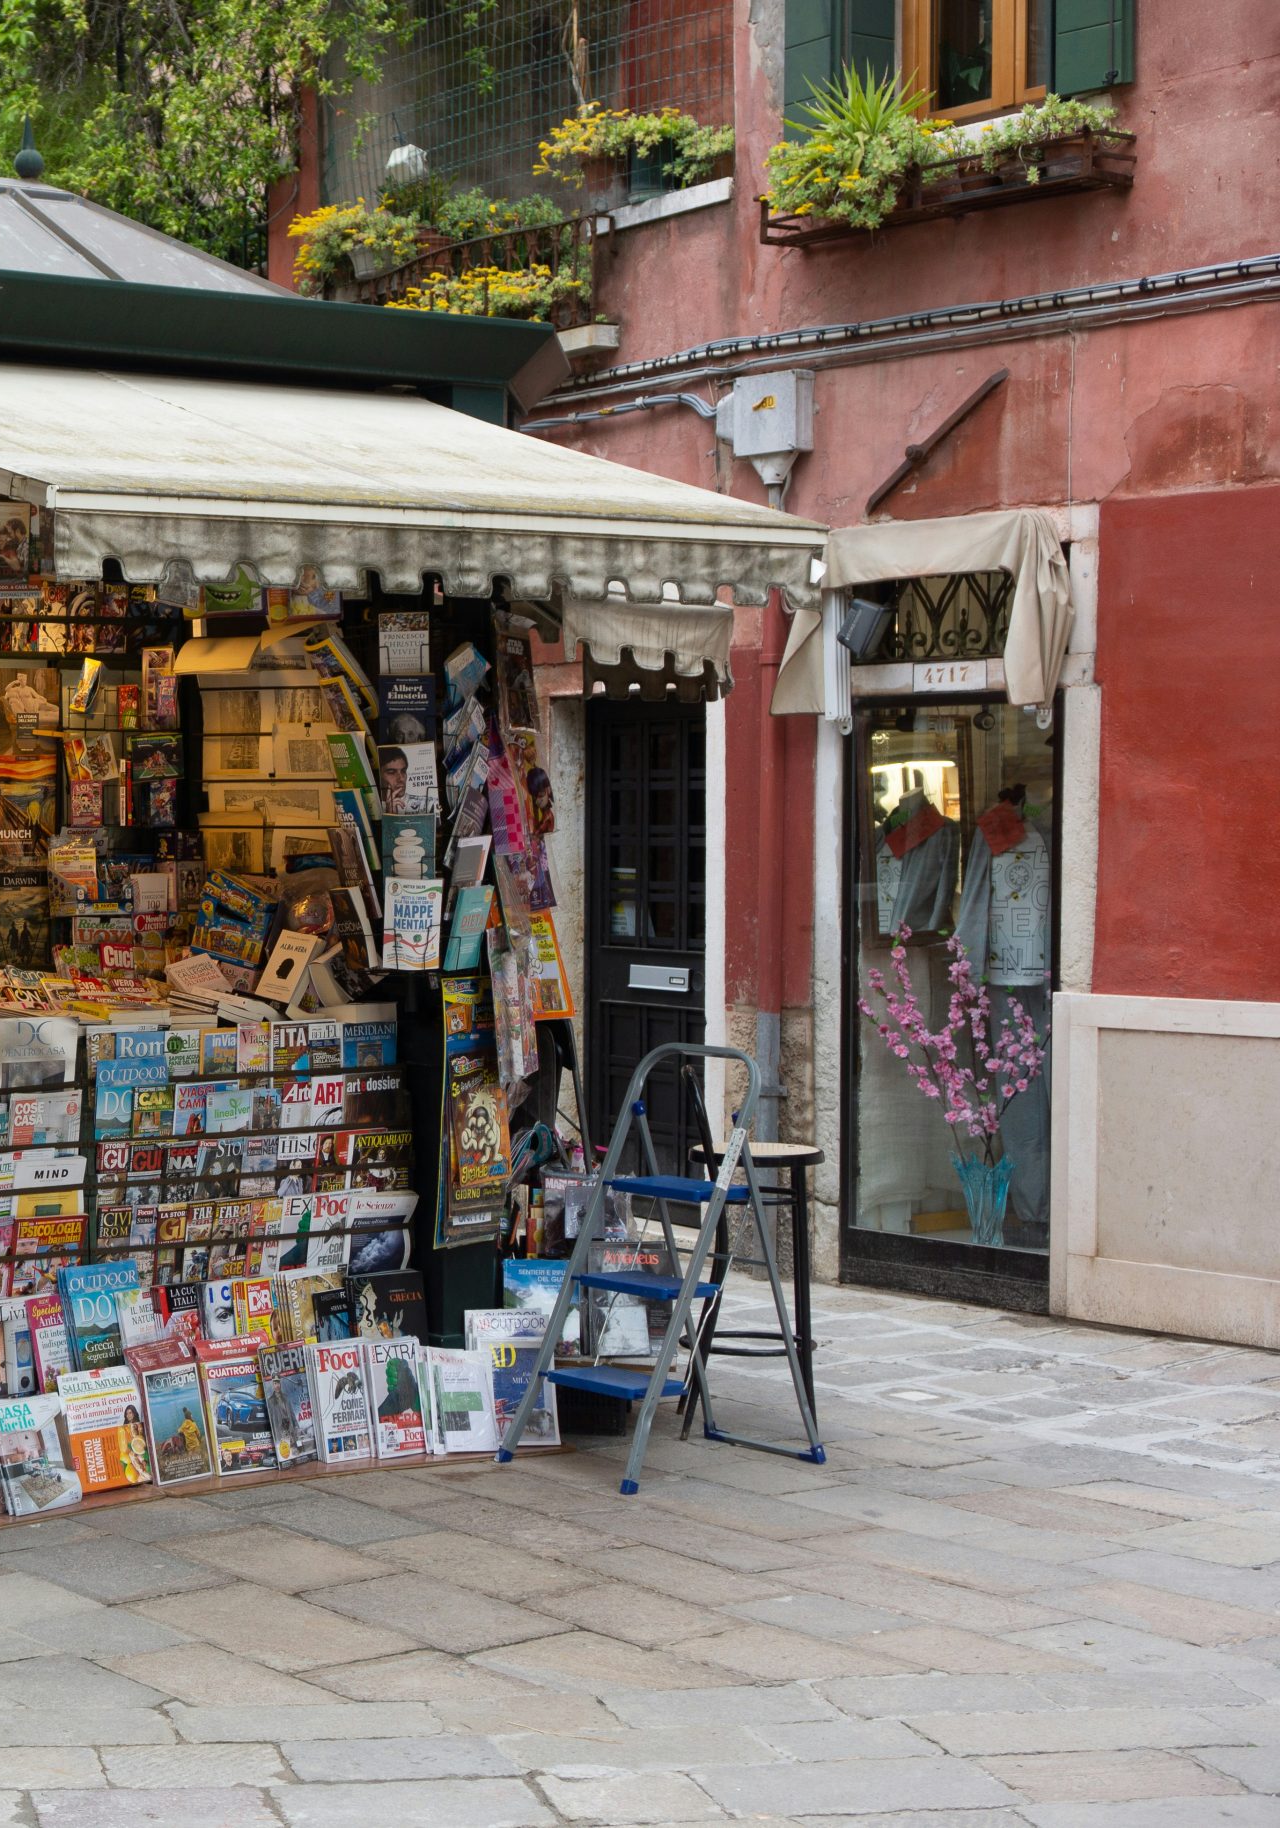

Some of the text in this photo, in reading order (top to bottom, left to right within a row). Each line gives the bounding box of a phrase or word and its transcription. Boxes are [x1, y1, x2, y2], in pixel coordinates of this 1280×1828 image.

[925, 666, 970, 684] 4717
[391, 684, 423, 692] Albert
[388, 691, 427, 700] Einstein
[3, 876, 38, 886] DARWIN
[393, 904, 433, 918] MAPPE
[79, 919, 113, 929] Ricette
[394, 919, 433, 929] MENTALI
[79, 930, 133, 943] UOVA
[104, 946, 133, 970] Cuci
[344, 1023, 395, 1037] MERIDIANI
[280, 1028, 307, 1048] ITA
[99, 1066, 166, 1083] OUTDOOR
[15, 1102, 45, 1114] COSE
[14, 1115, 44, 1127] CASA
[355, 1133, 412, 1148] ANTIQUARIATO
[34, 1169, 69, 1179] MIND
[19, 1222, 82, 1238] PSICOLOGIA
[48, 1234, 80, 1244] bambini
[70, 1270, 136, 1292] OUTDOOR
[389, 1292, 423, 1302] GRECIA
[0, 1305, 26, 1322] Livi
[32, 1303, 62, 1319] Speciale
[39, 1314, 64, 1327] AntiA
[132, 1313, 156, 1324] NATUR
[490, 1317, 546, 1329] OUTDOOR
[85, 1340, 114, 1353] Grecia
[86, 1350, 109, 1363] segreta
[63, 1376, 131, 1395] SALUTE NATURALE
[108, 1394, 137, 1406] cervello
[341, 1397, 364, 1410] COME
[88, 1408, 112, 1419] ammali
[113, 1406, 123, 1416] più
[332, 1408, 367, 1424] FERMAR
[0, 1417, 36, 1434] facile
[84, 1440, 95, 1483] ZENZERO
[94, 1437, 105, 1475] LIMONE
